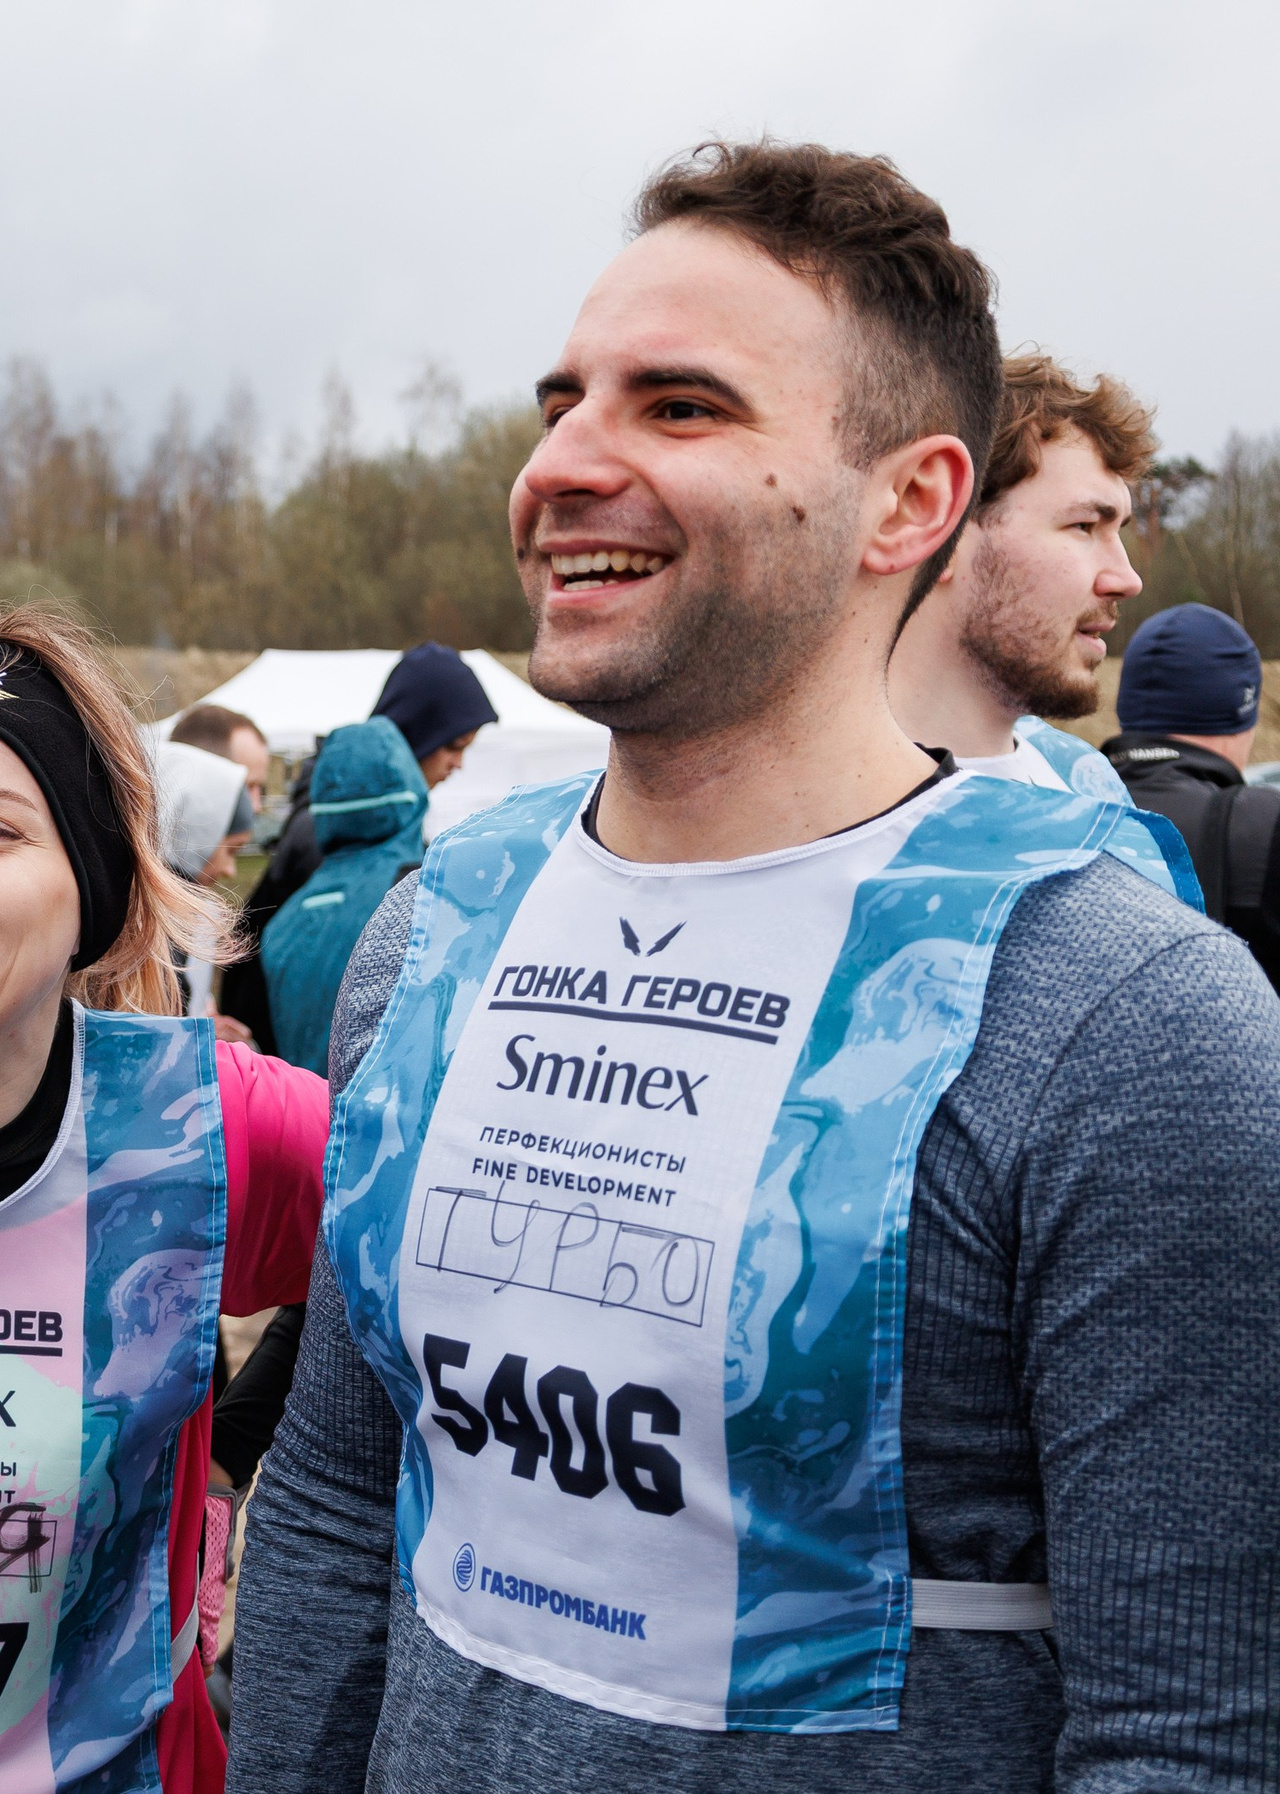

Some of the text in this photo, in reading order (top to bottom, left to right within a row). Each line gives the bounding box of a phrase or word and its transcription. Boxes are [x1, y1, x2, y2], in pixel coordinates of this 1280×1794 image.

[493, 964, 791, 1030] ГОНКА ГЕРОЕВ
[496, 1032, 709, 1117] Sminex
[472, 1158, 677, 1207] FINE DEVELOPMENT
[479, 1126, 687, 1174] ПЕРФЕКЦИОНИСТЫ
[423, 1332, 686, 1517] 5406
[480, 1566, 646, 1640] ГАЗПРОМБАНК
